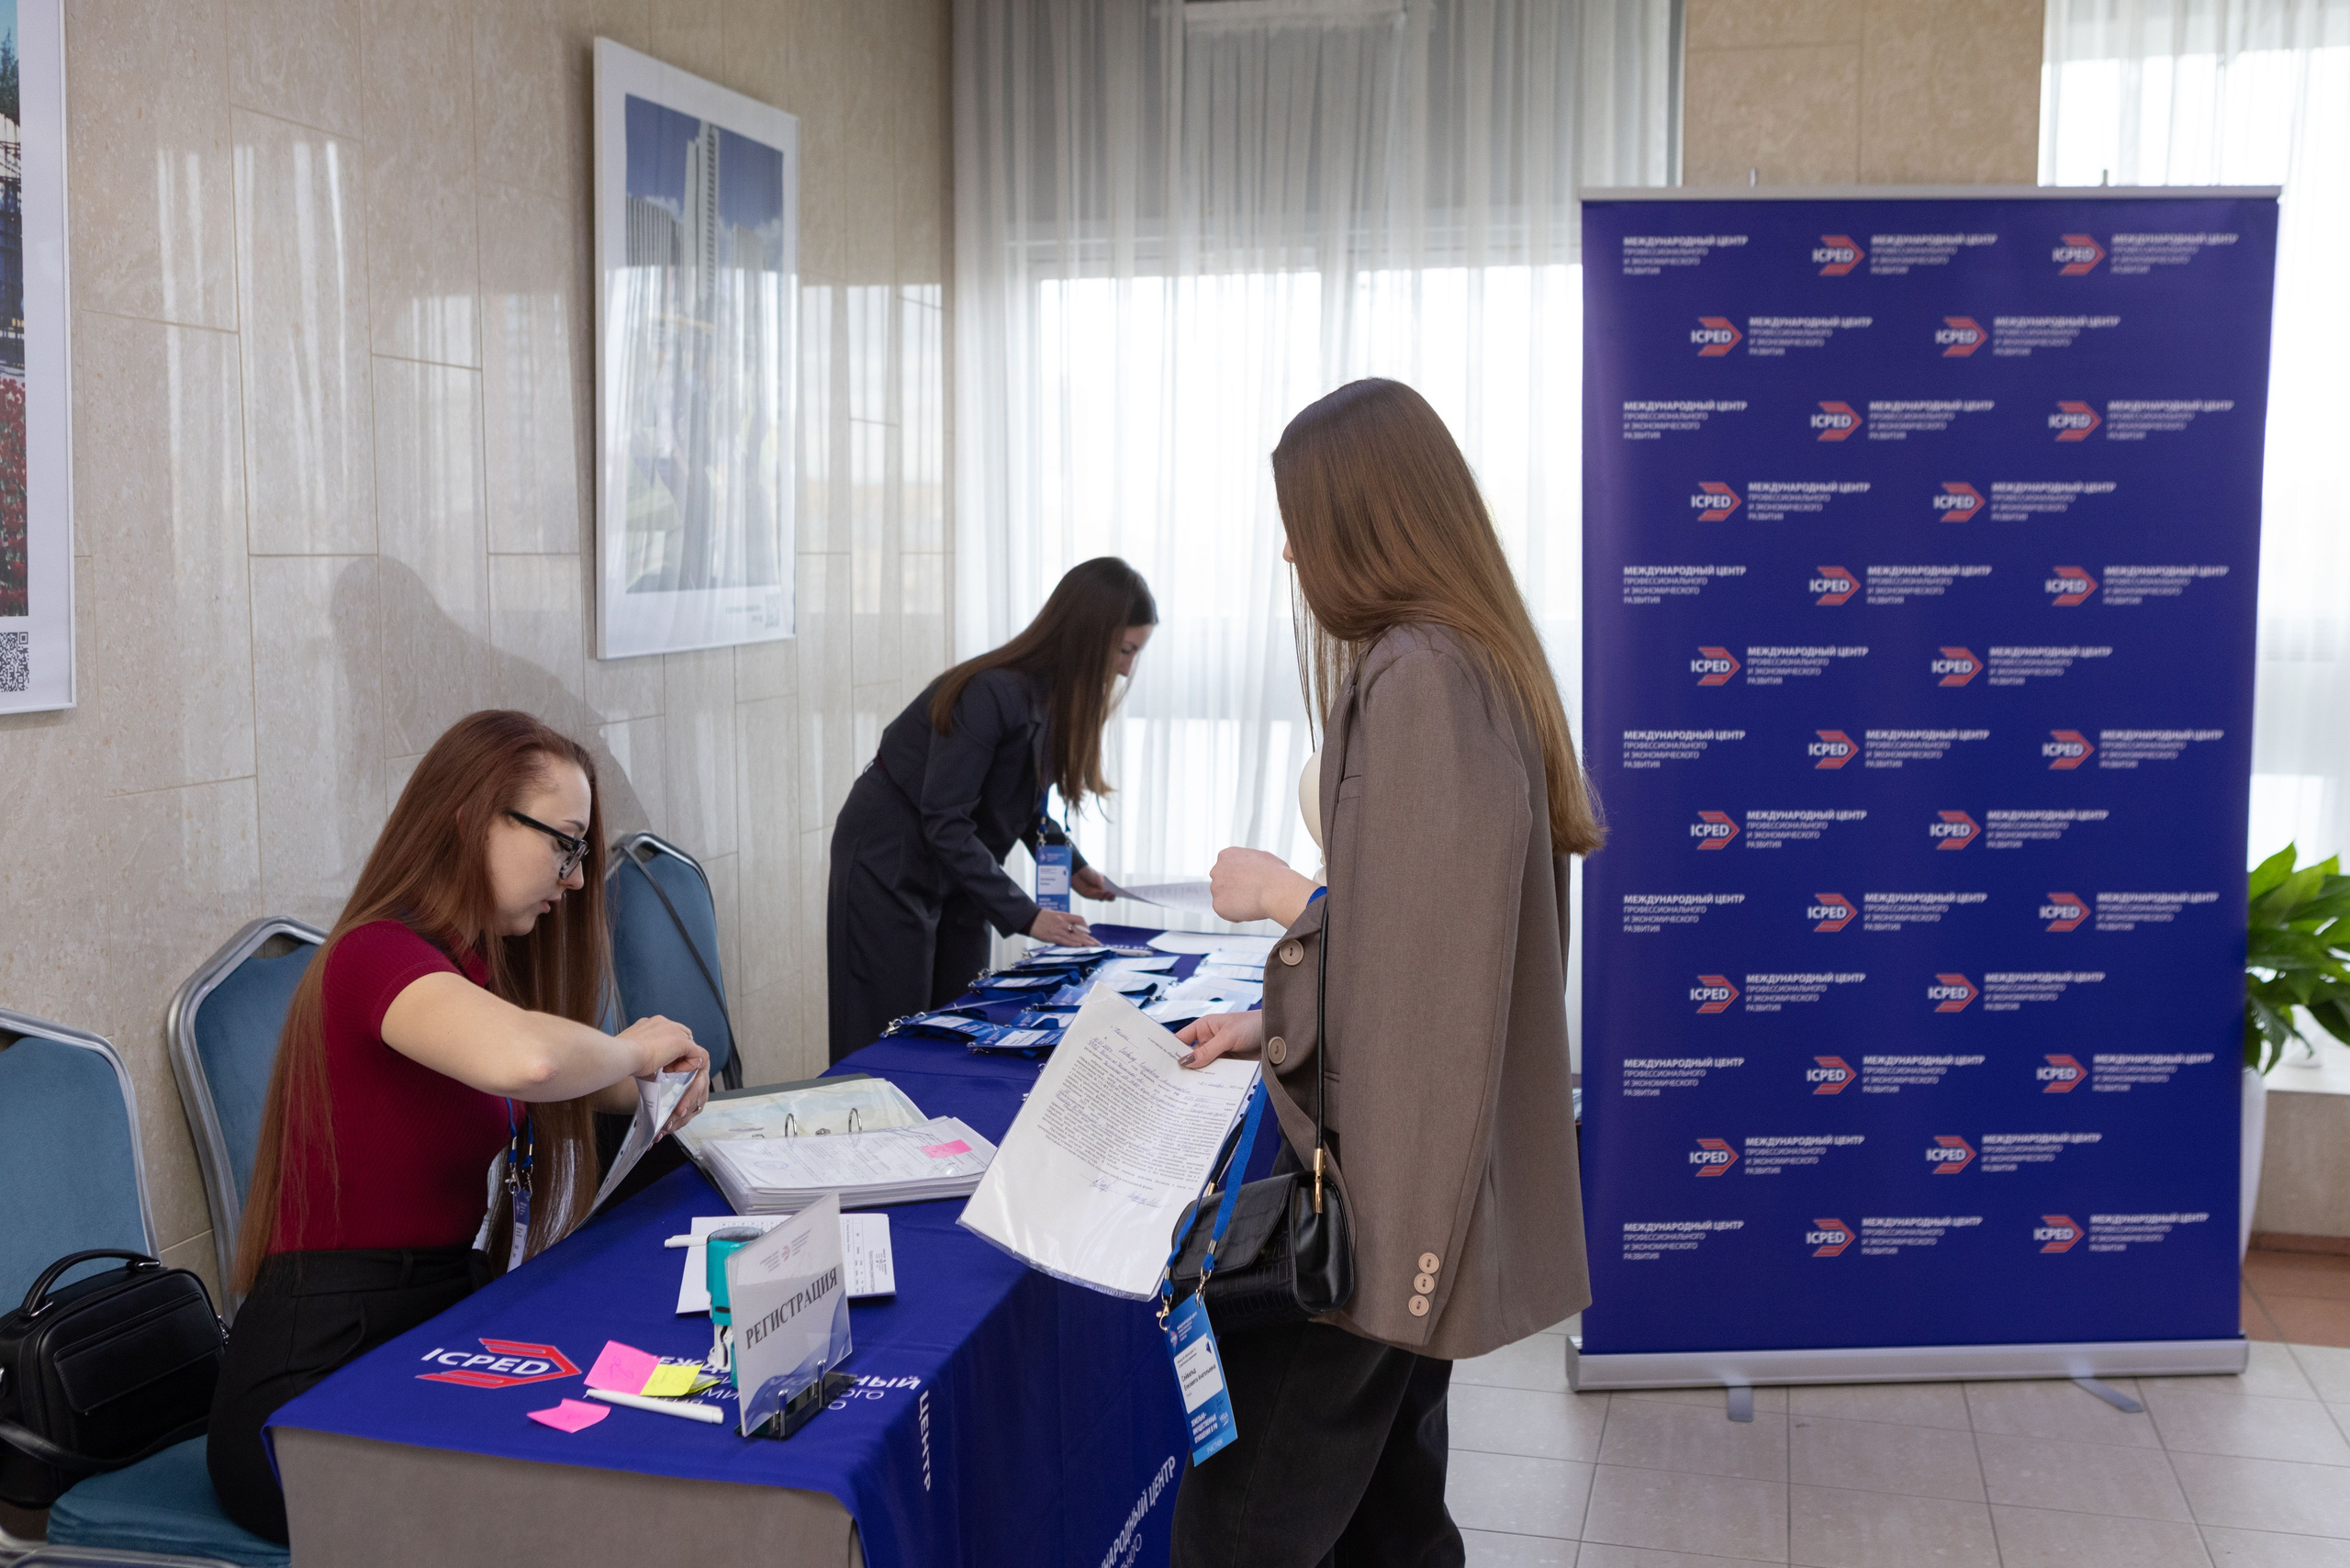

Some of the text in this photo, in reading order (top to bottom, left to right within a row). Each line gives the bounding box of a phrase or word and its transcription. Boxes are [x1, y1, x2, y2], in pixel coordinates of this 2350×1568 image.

[1623, 235, 1748, 247] МЕЖДУНАРОДНЫЙ ЦЕНТР
[1813, 248, 1854, 263] ICPED
[2053, 248, 2096, 263] ICPED
[1749, 316, 1873, 328] МЕЖДУНАРОДНЫЙ ЦЕНТР
[1691, 329, 1732, 343] ICPED
[1936, 329, 1977, 343] ICPED
[1623, 400, 1747, 412] МЕЖДУНАРОДНЫЙ ЦЕНТР
[1811, 414, 1852, 429] ICPED
[2049, 414, 2091, 429] ICPED
[1748, 481, 1870, 493] МЕЖДУНАРОДНЫЙ ЦЕНТР
[1691, 494, 1730, 509] ICPED
[1933, 495, 1975, 510] ICPED
[1623, 566, 1746, 577] МЕЖДУНАРОДНЫЙ ЦЕНТР
[1809, 579, 1850, 594] ICPED
[2045, 579, 2087, 594] ICPED
[1747, 645, 1868, 657] МЕЖДУНАРОДНЫЙ ЦЕНТР
[1691, 660, 1730, 673] ICPED
[1931, 660, 1973, 673] ICPED
[1623, 730, 1745, 742] МЕЖДУНАРОДНЫЙ ЦЕНТР
[1808, 743, 1848, 756] ICPED
[2042, 743, 2084, 756] ICPED
[1746, 810, 1867, 822] МЕЖДУНАРОДНЫЙ ЦЕНТР
[1691, 823, 1729, 836] ICPED
[1930, 823, 1970, 836] ICPED
[1623, 893, 1745, 905] МЕЖДУНАРОДНЫЙ ЦЕНТР
[1807, 906, 1847, 919] ICPED
[2040, 905, 2080, 918] ICPED
[1746, 972, 1866, 984] МЕЖДУНАРОДНЫЙ ЦЕНТР
[1690, 988, 1729, 1001] ICPED
[1928, 987, 1968, 1000] ICPED
[1624, 1057, 1744, 1069] МЕЖДУНАРОДНЫЙ ЦЕНТР
[1807, 1069, 1846, 1081] ICPED
[2037, 1067, 2077, 1080] ICPED
[1745, 1135, 1864, 1147] МЕЖДУНАРОДНЫЙ ЦЕНТР
[1690, 1151, 1729, 1164] ICPED
[1926, 1148, 1966, 1161] ICPED
[1623, 1219, 1744, 1231] МЕЖДУНАРОДНЫЙ ЦЕНТР
[1807, 1231, 1845, 1244] ICPED
[2034, 1227, 2074, 1240] ICPED
[745, 1267, 837, 1350] РЕГИСТРАЦИЯ
[420, 1348, 550, 1374] ICPED
[919, 1390, 931, 1492] ЦЕНТР
[1098, 1489, 1149, 1568] НАРОДНЫЙ
[1148, 1455, 1176, 1506] ЦЕНТР
